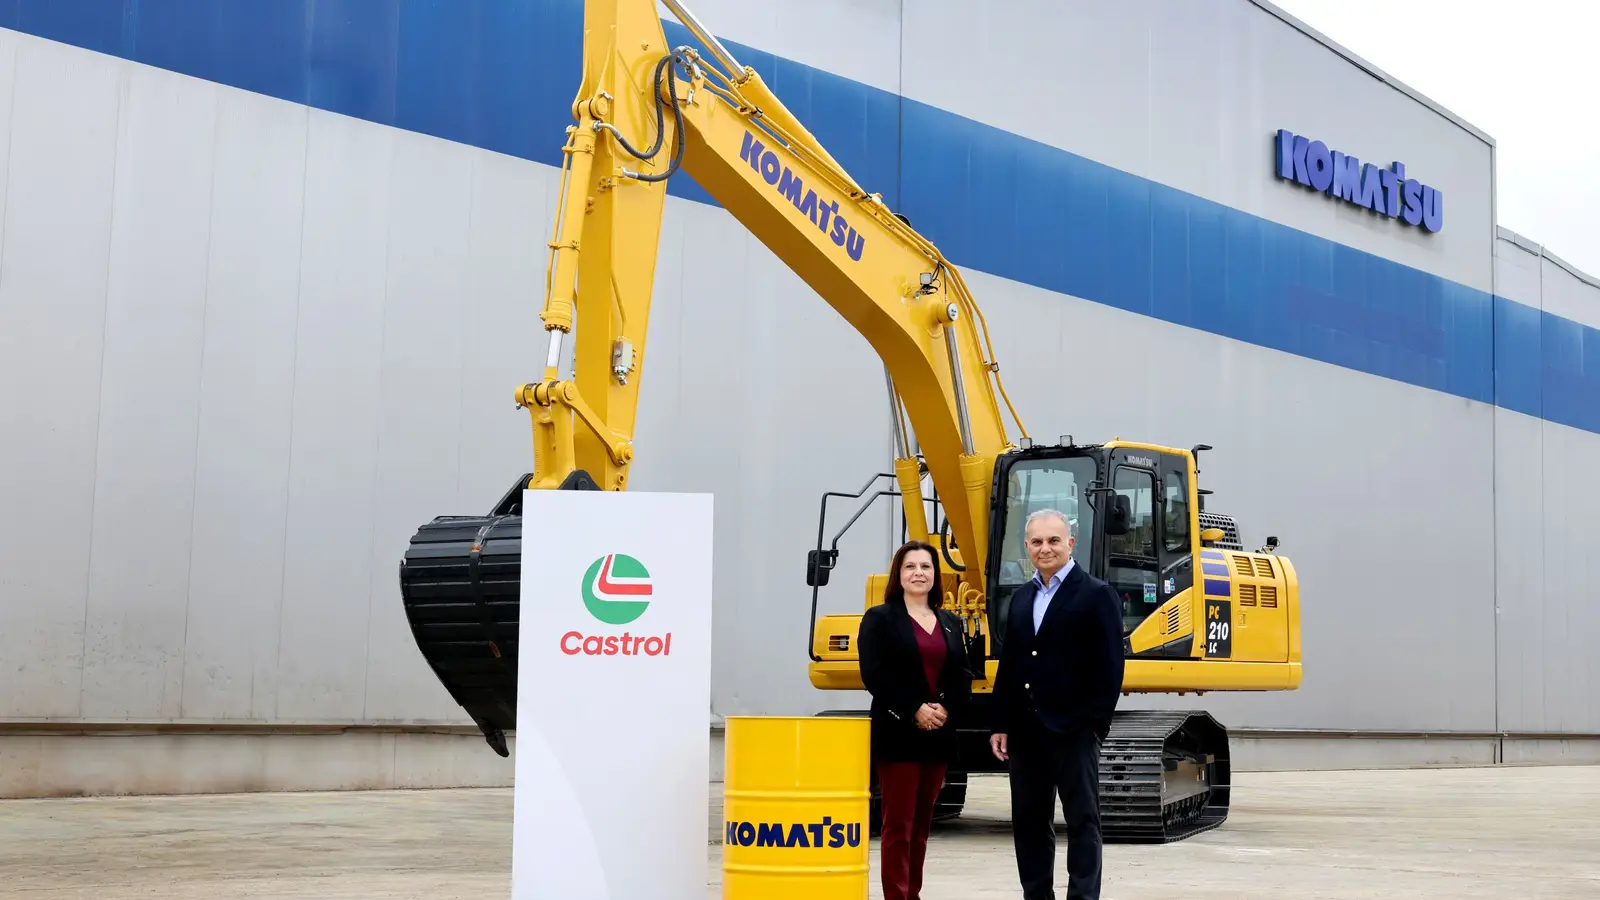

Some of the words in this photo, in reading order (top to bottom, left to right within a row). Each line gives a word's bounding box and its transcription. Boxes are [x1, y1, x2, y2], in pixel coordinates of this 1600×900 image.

[1276, 129, 1443, 233] KOMATSU
[739, 129, 865, 262] KOMATSU
[1208, 605, 1220, 620] PC
[1208, 621, 1229, 640] 210
[560, 631, 671, 656] Castrol
[1208, 641, 1218, 654] LC
[726, 816, 861, 848] KOMATSU
